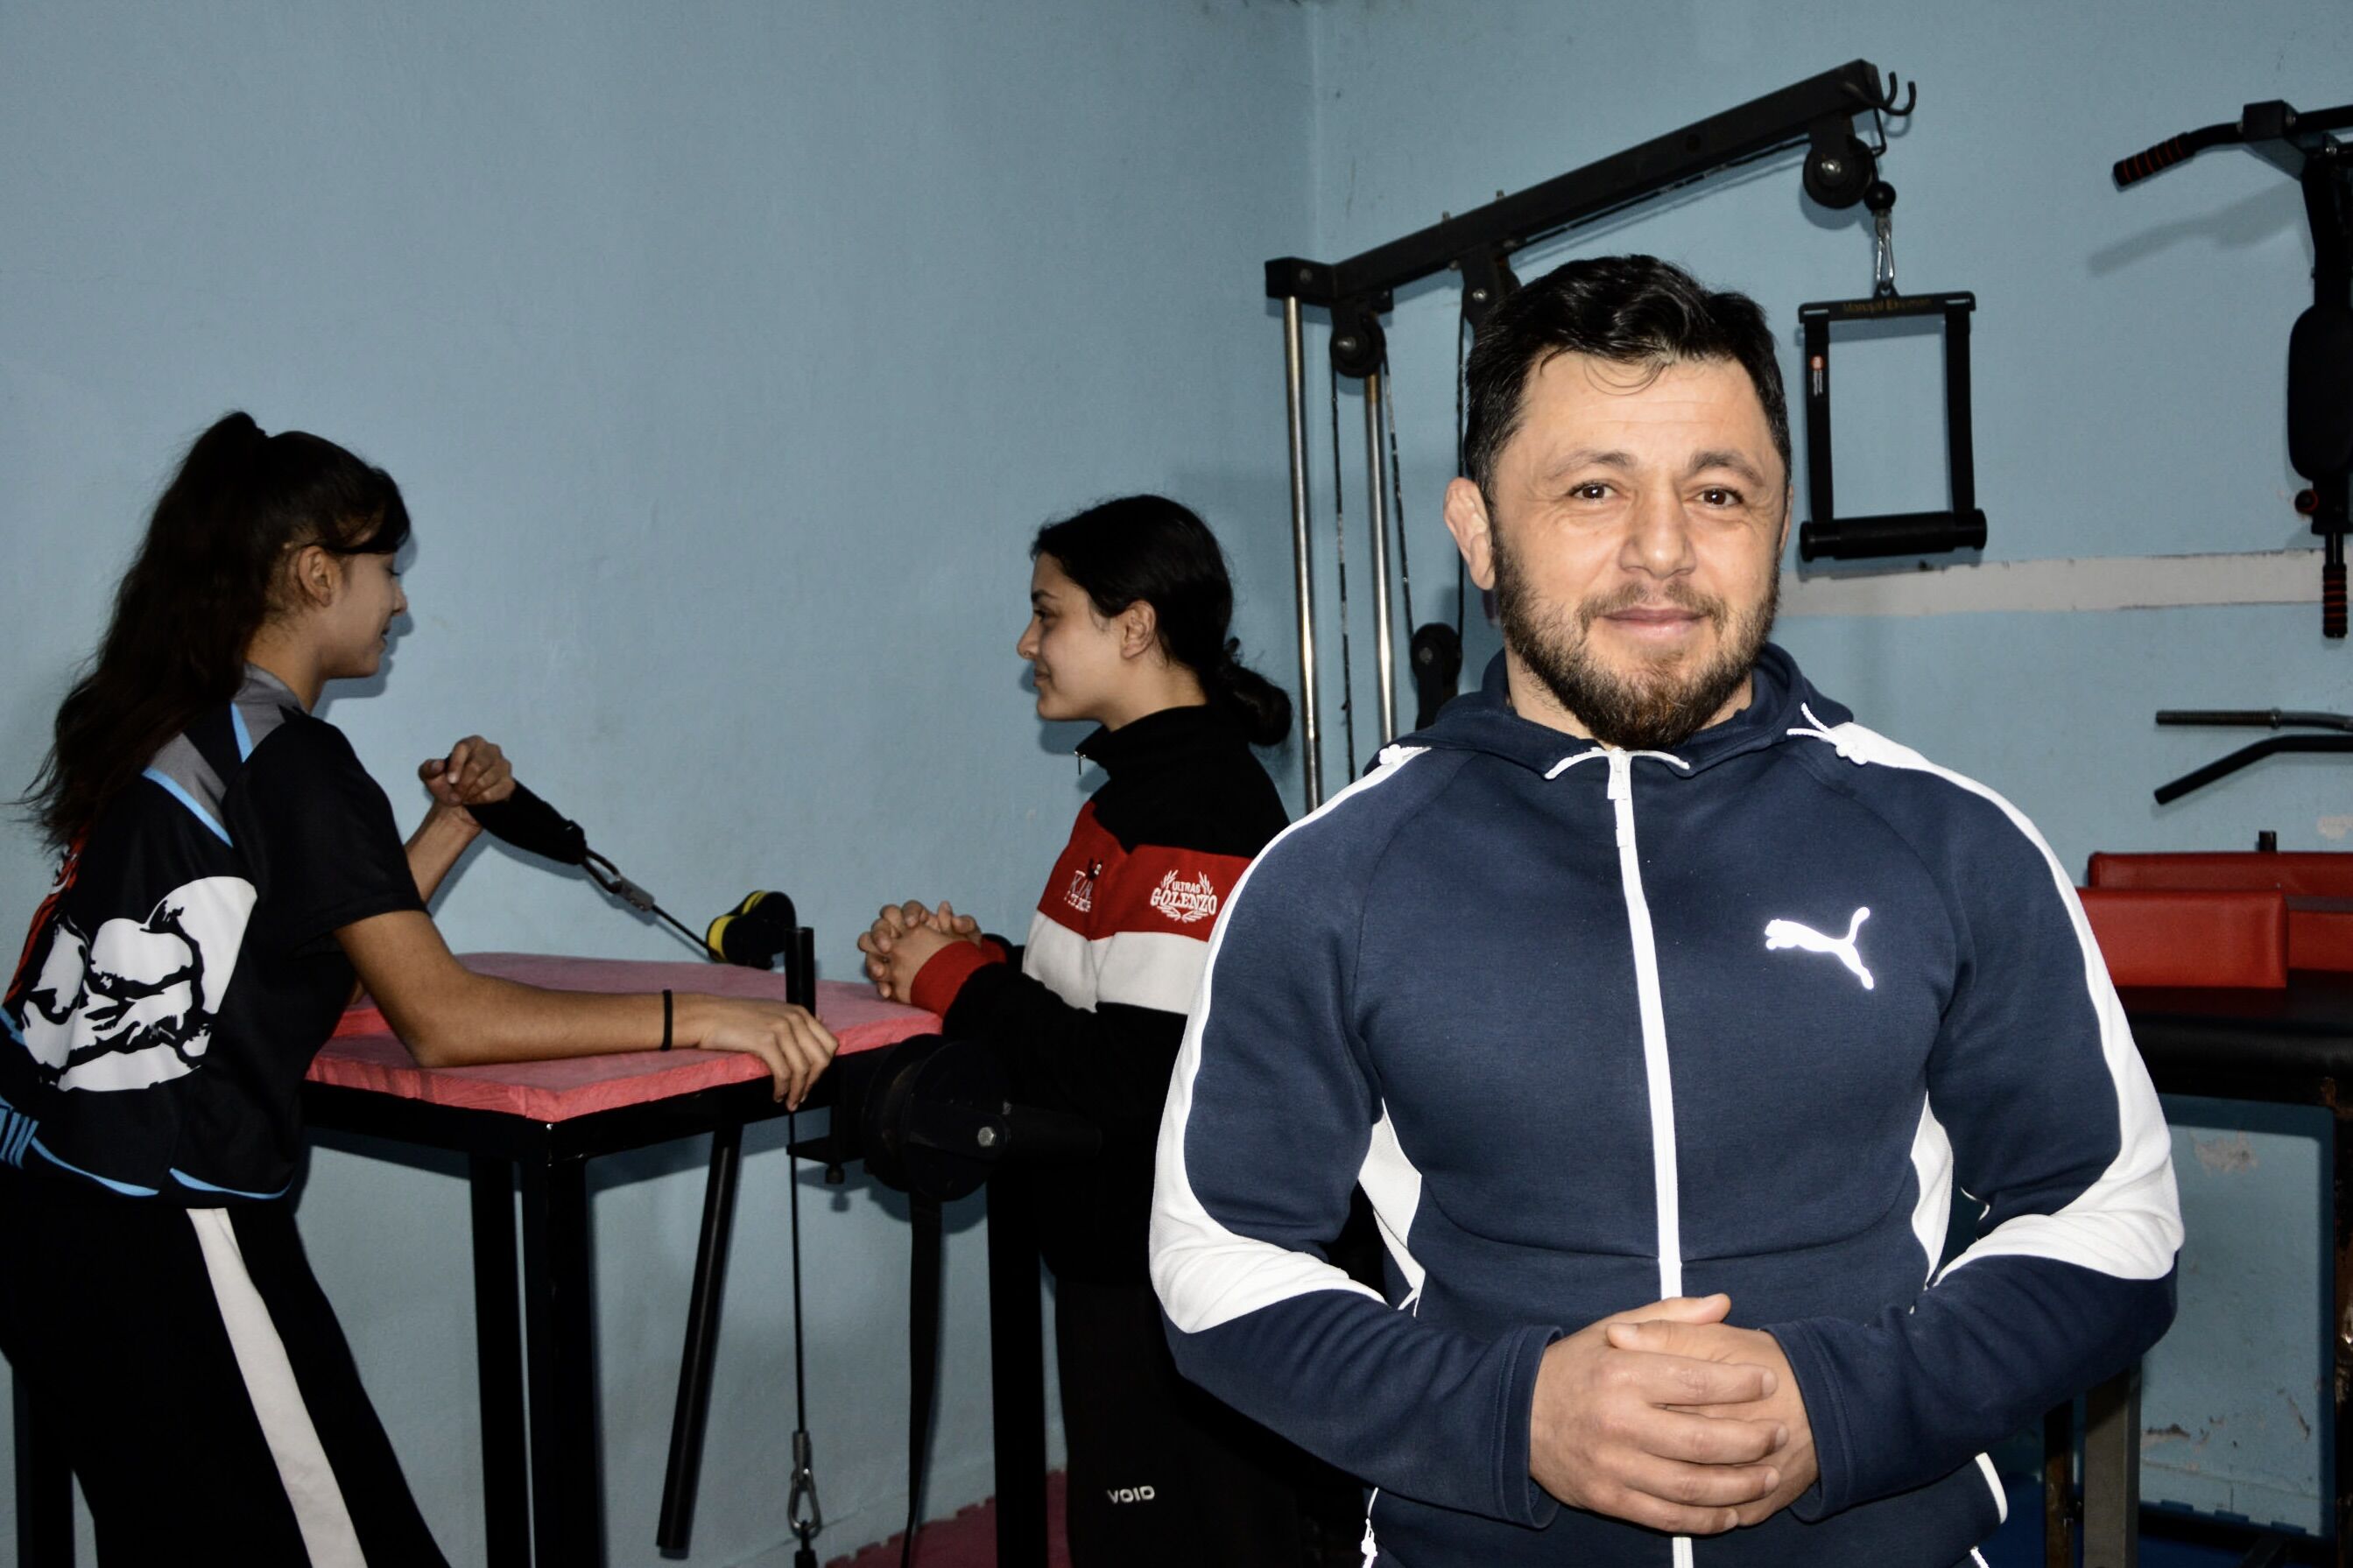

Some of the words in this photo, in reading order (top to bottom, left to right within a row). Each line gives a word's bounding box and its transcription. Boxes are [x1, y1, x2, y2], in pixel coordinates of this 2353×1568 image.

[1172, 881, 1201, 893] ULTRAS
[1150, 887, 1217, 916] GOLENZO
[1106, 1485, 1155, 1503] VOID
